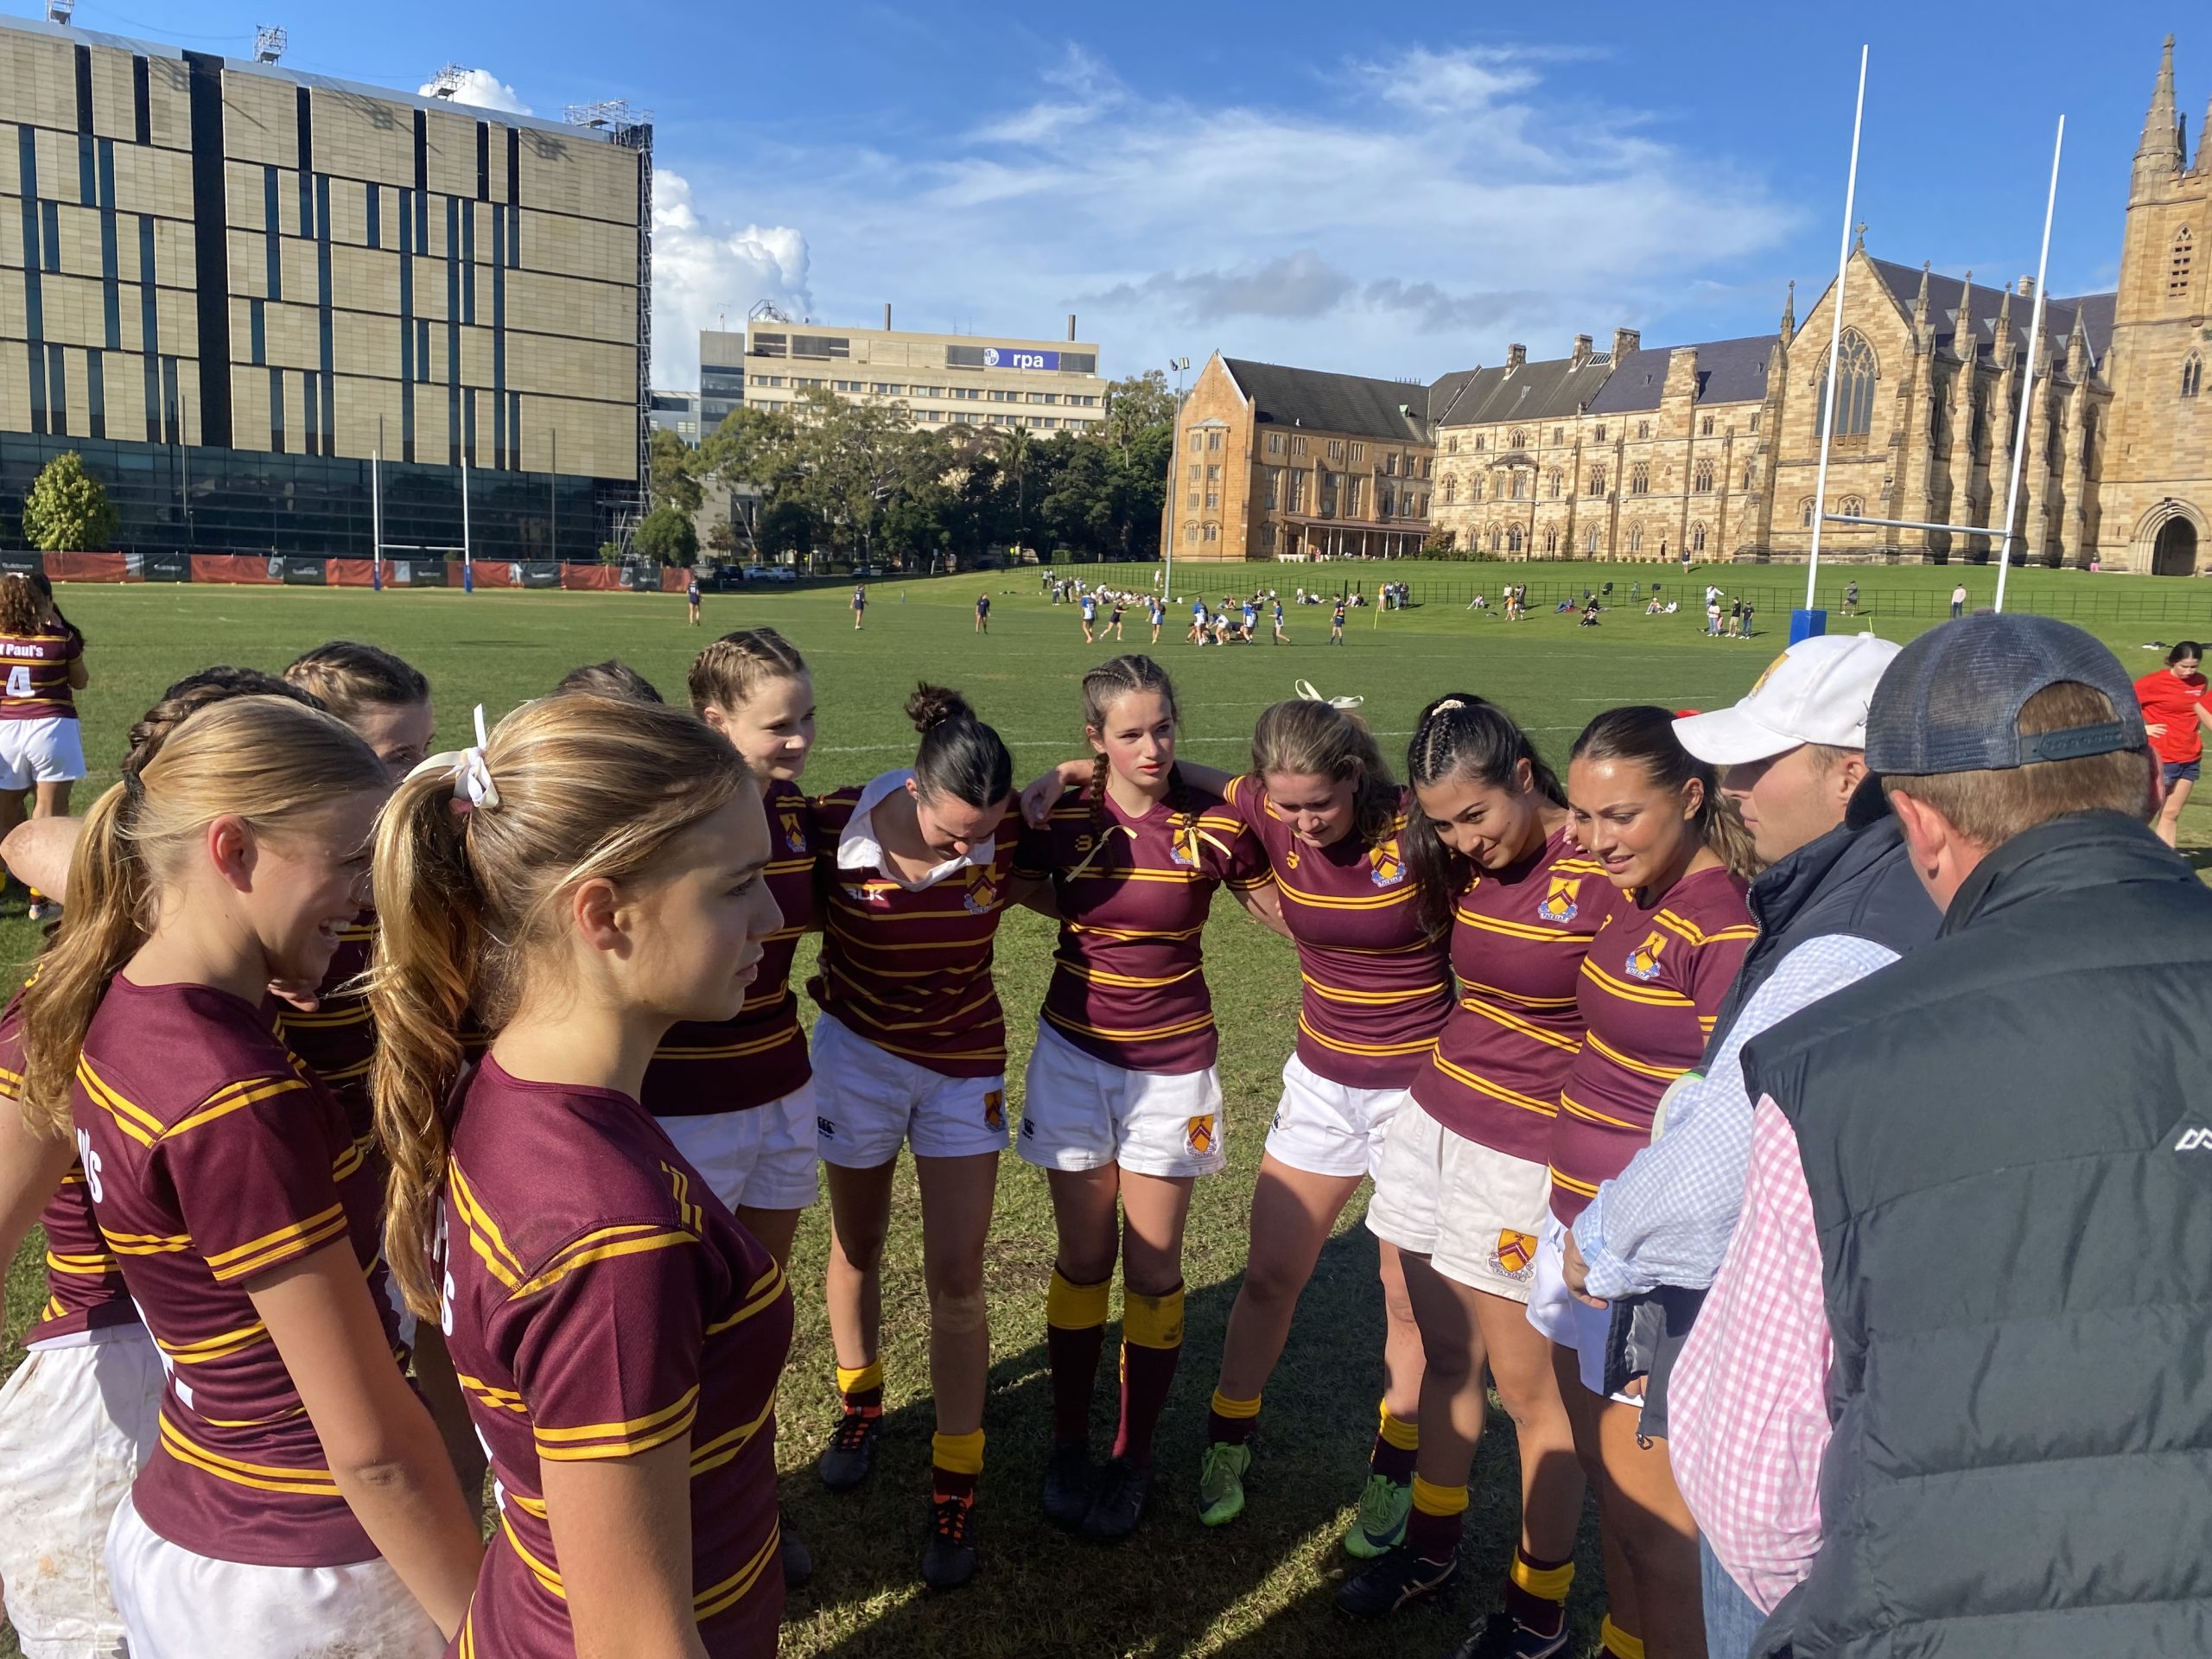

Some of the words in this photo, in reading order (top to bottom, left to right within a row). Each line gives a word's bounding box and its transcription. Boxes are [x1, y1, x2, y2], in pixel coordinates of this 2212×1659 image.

[1013, 353, 1044, 369] rpa
[6, 644, 43, 657] Paul's
[6, 666, 35, 697] 4
